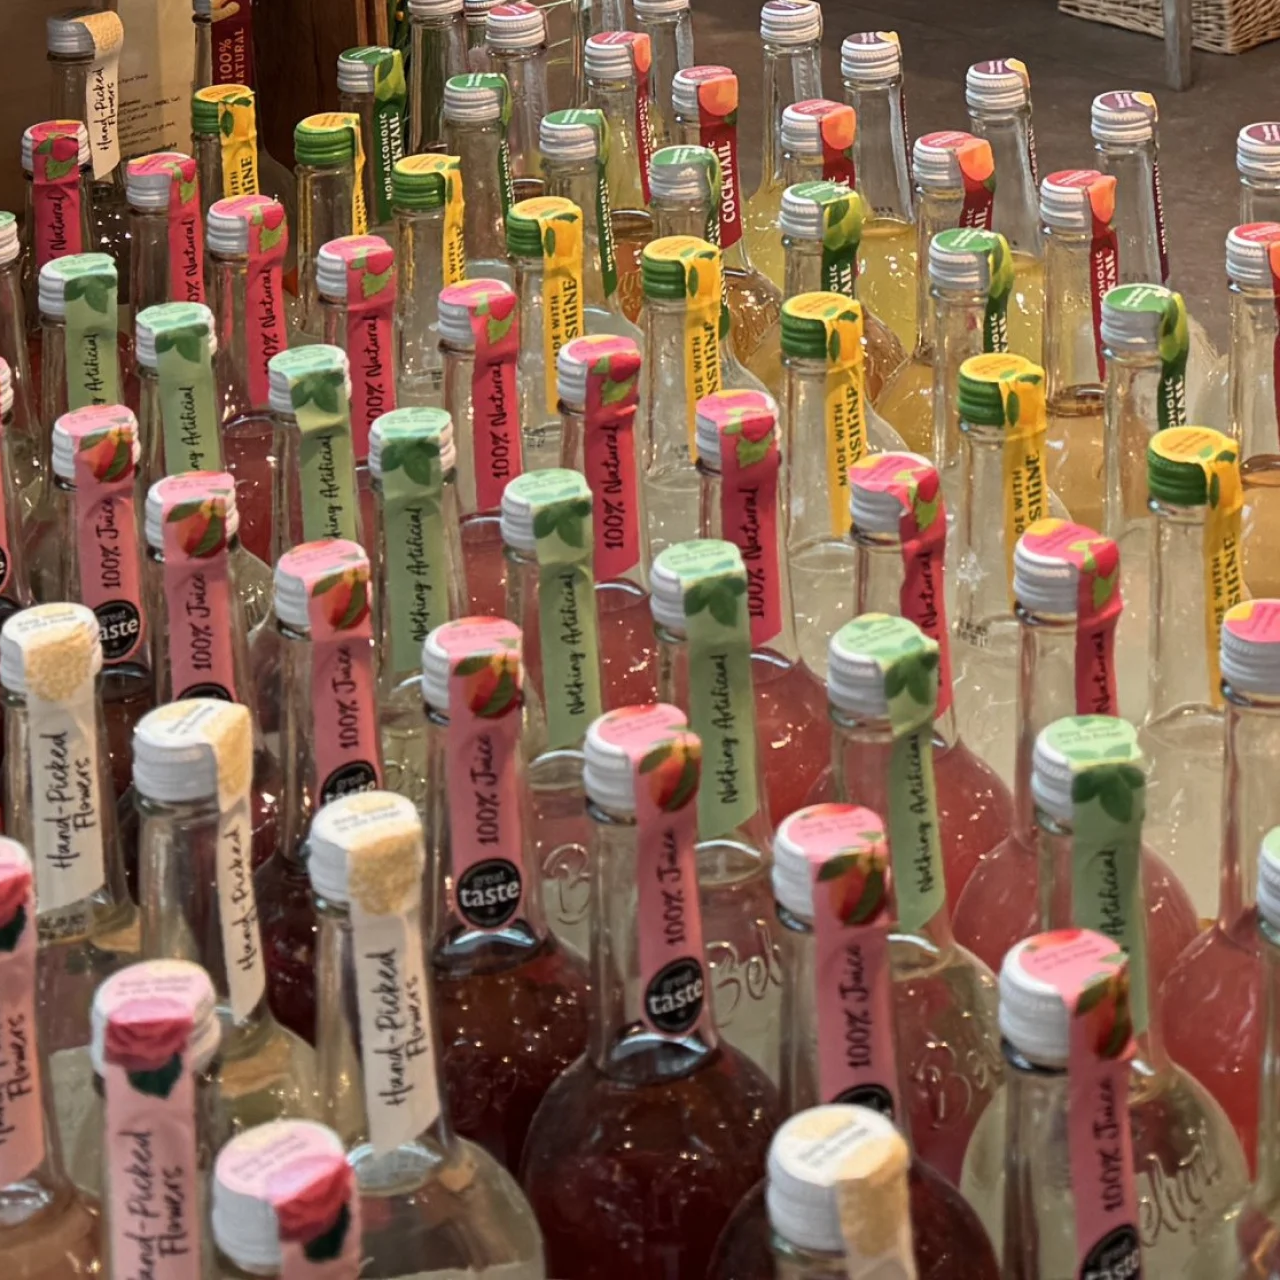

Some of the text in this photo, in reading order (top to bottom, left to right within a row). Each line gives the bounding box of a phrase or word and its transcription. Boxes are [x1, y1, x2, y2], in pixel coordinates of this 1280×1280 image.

[378, 111, 394, 201] NON-ALCOHOLIC
[722, 139, 736, 224] COCKTAIL
[259, 264, 275, 330] Natural
[551, 294, 560, 329] WITH
[364, 314, 379, 380] Natural
[692, 335, 701, 371] WITH
[494, 359, 504, 426] Natural
[320, 433, 334, 501] Artificial
[604, 422, 624, 495] Natural
[833, 402, 848, 487] MADE WITH
[738, 487, 759, 559] Natural
[1012, 469, 1023, 505] WITH
[406, 507, 431, 577] Artificial
[916, 550, 938, 628] Natural
[559, 572, 585, 715] Nothing Artificial
[1091, 630, 1106, 714] Natural
[470, 733, 494, 785] Juice
[712, 653, 739, 805] Nothing Artificial
[40, 730, 81, 870] Hand-Picked
[909, 733, 932, 895] Nothing Artificial
[223, 825, 257, 973] Hand-Picked
[459, 880, 520, 909] taste
[1100, 847, 1119, 935] Artificial
[840, 943, 864, 998] Juice
[366, 947, 407, 1107] Hand-Picked
